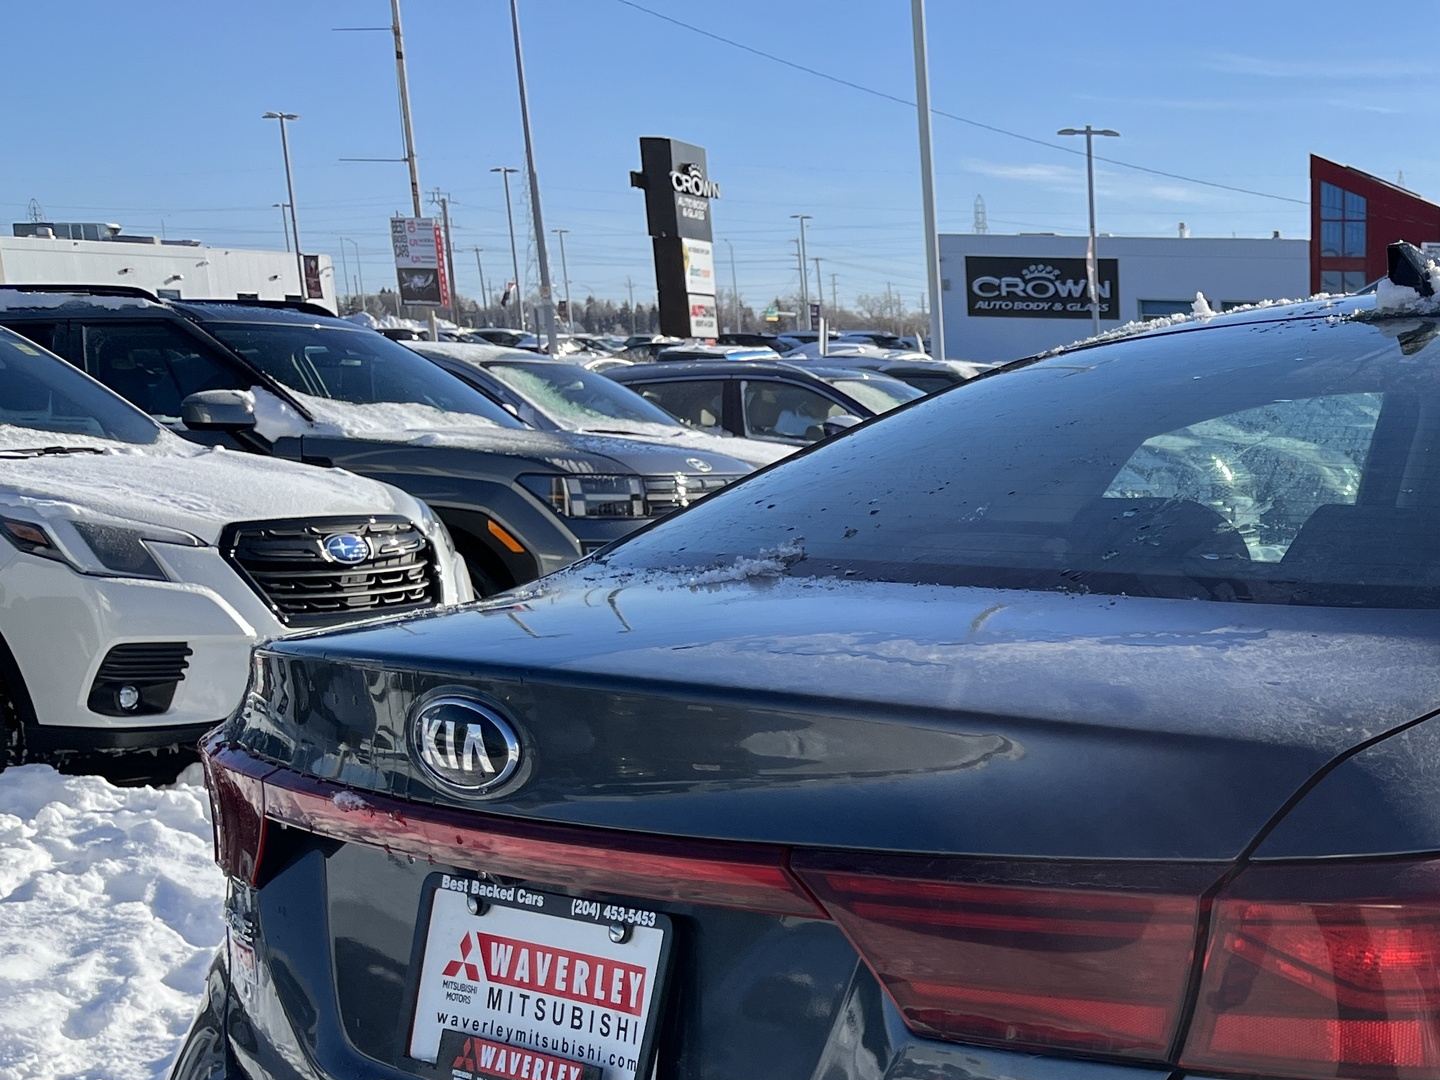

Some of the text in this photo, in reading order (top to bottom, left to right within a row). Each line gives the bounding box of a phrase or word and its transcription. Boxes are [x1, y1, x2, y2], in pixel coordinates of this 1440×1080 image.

[671, 172, 721, 199] CROWN
[1052, 302, 1065, 312] &
[421, 717, 496, 773] KIA
[442, 875, 656, 927] Best Backed Cars (204) 453-5453
[442, 980, 478, 995] MITSUBISHI
[446, 992, 471, 1005] MOTORS
[490, 941, 644, 1009] WAVERLEY
[437, 1011, 637, 1072] waverleymitsubishi.com
[486, 987, 639, 1045] MITSUBISHI
